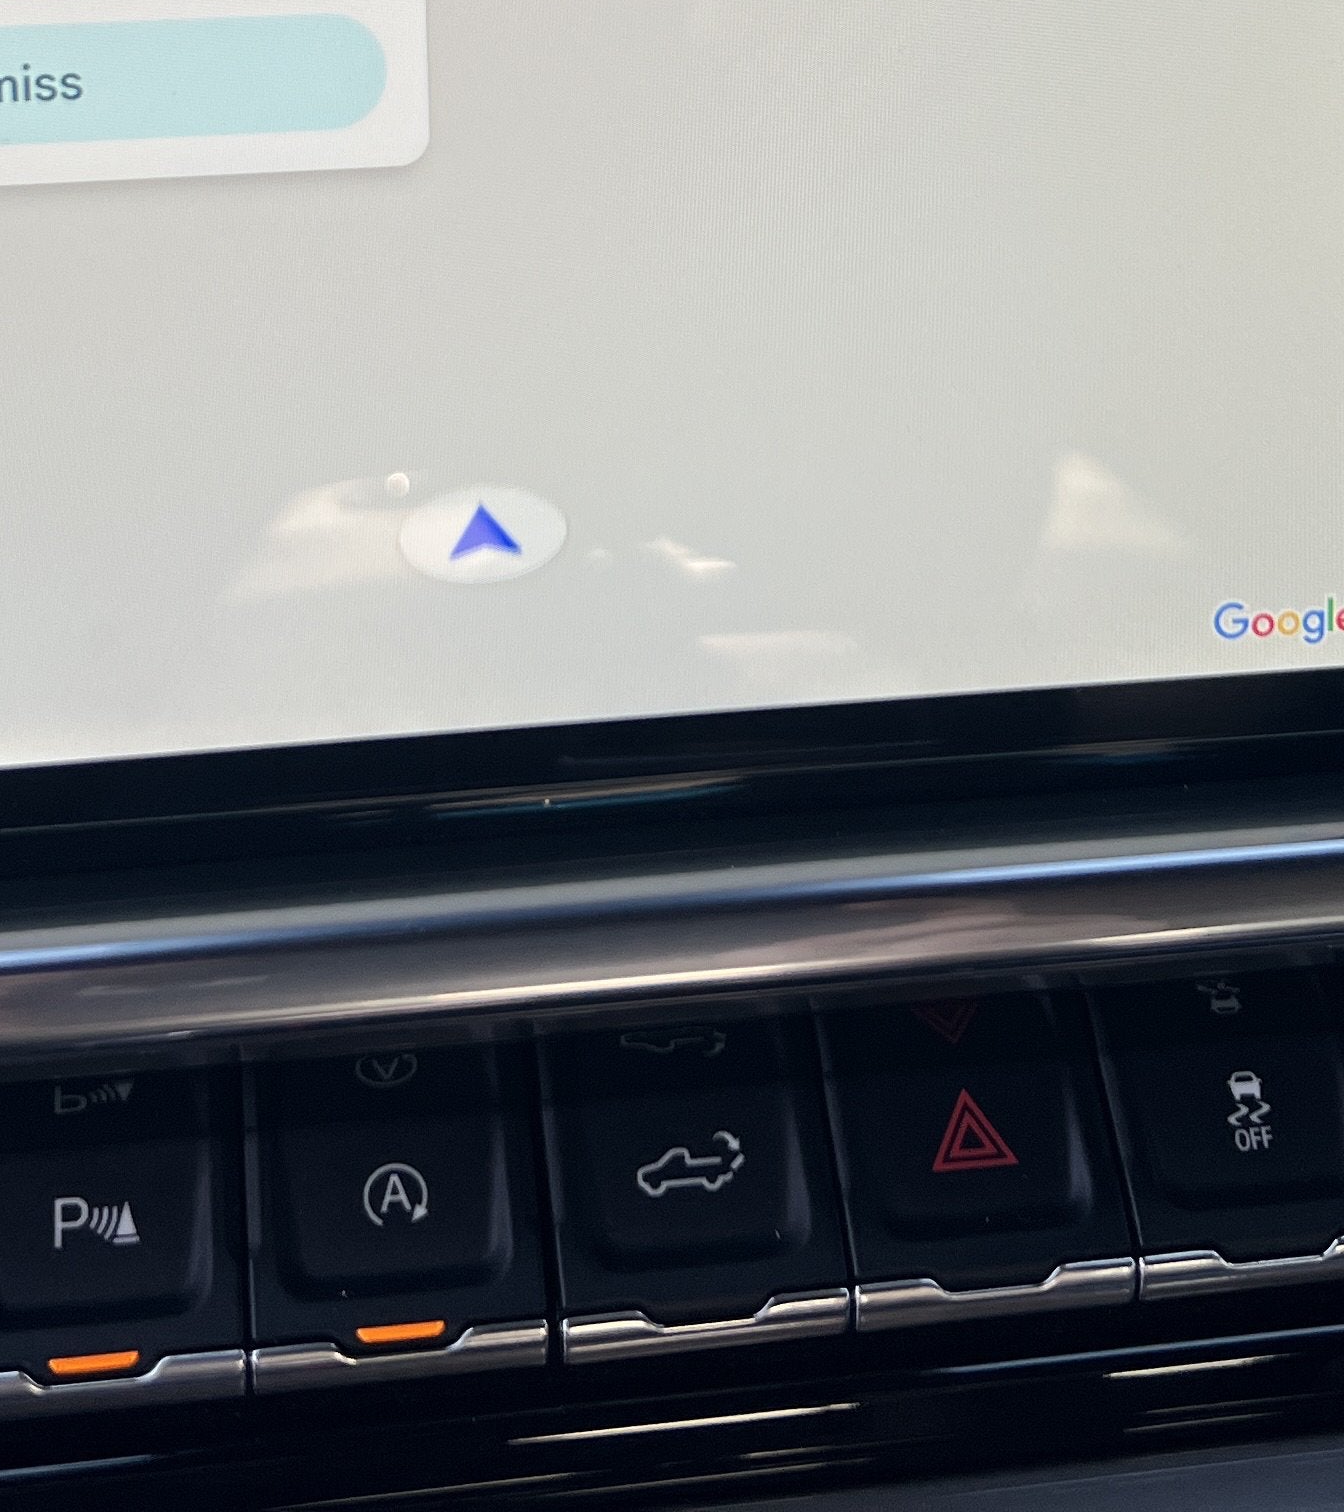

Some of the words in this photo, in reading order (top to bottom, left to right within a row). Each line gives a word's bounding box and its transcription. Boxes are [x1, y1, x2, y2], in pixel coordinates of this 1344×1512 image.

[1234, 1126, 1273, 1152] OFF
[380, 1173, 412, 1213] A
[54, 1196, 89, 1250] P
